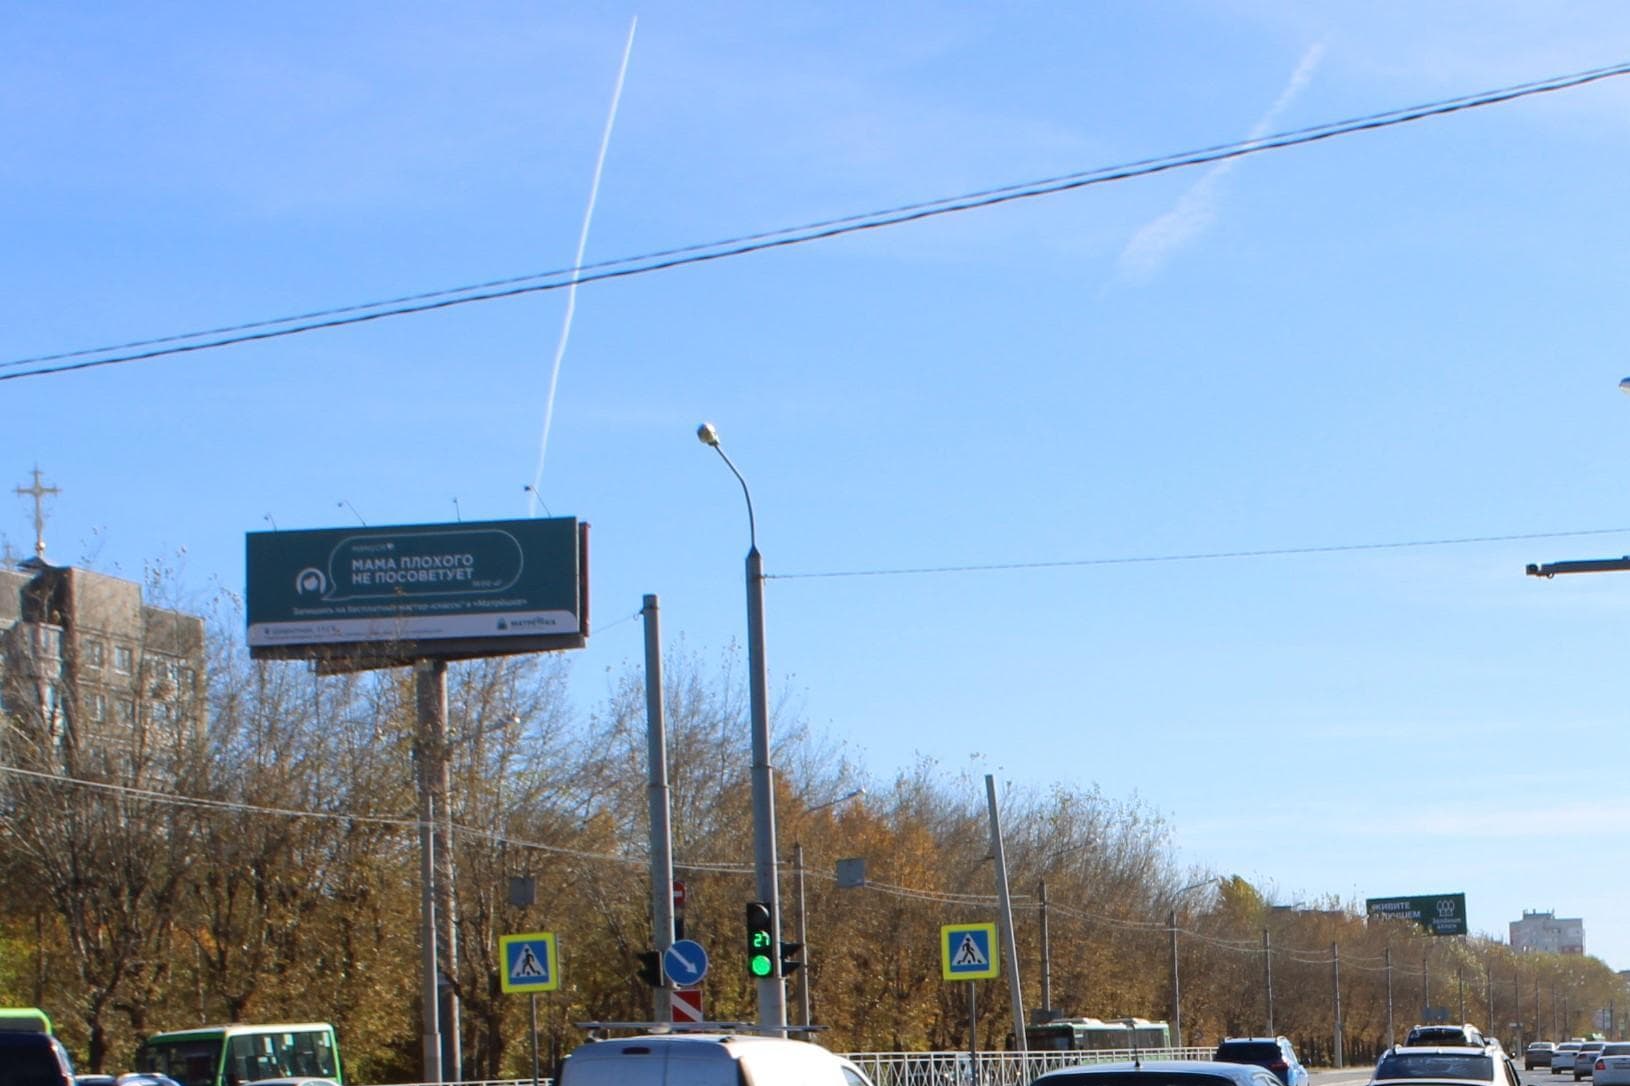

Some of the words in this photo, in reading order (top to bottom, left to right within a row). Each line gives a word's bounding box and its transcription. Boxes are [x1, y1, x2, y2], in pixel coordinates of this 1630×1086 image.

[351, 557, 397, 571] МАМА
[400, 554, 475, 569] ПЛОХОГО
[352, 573, 371, 584] НЕ
[374, 568, 474, 584] ПОСОВЕТУЕТ
[753, 933, 771, 947] 27
